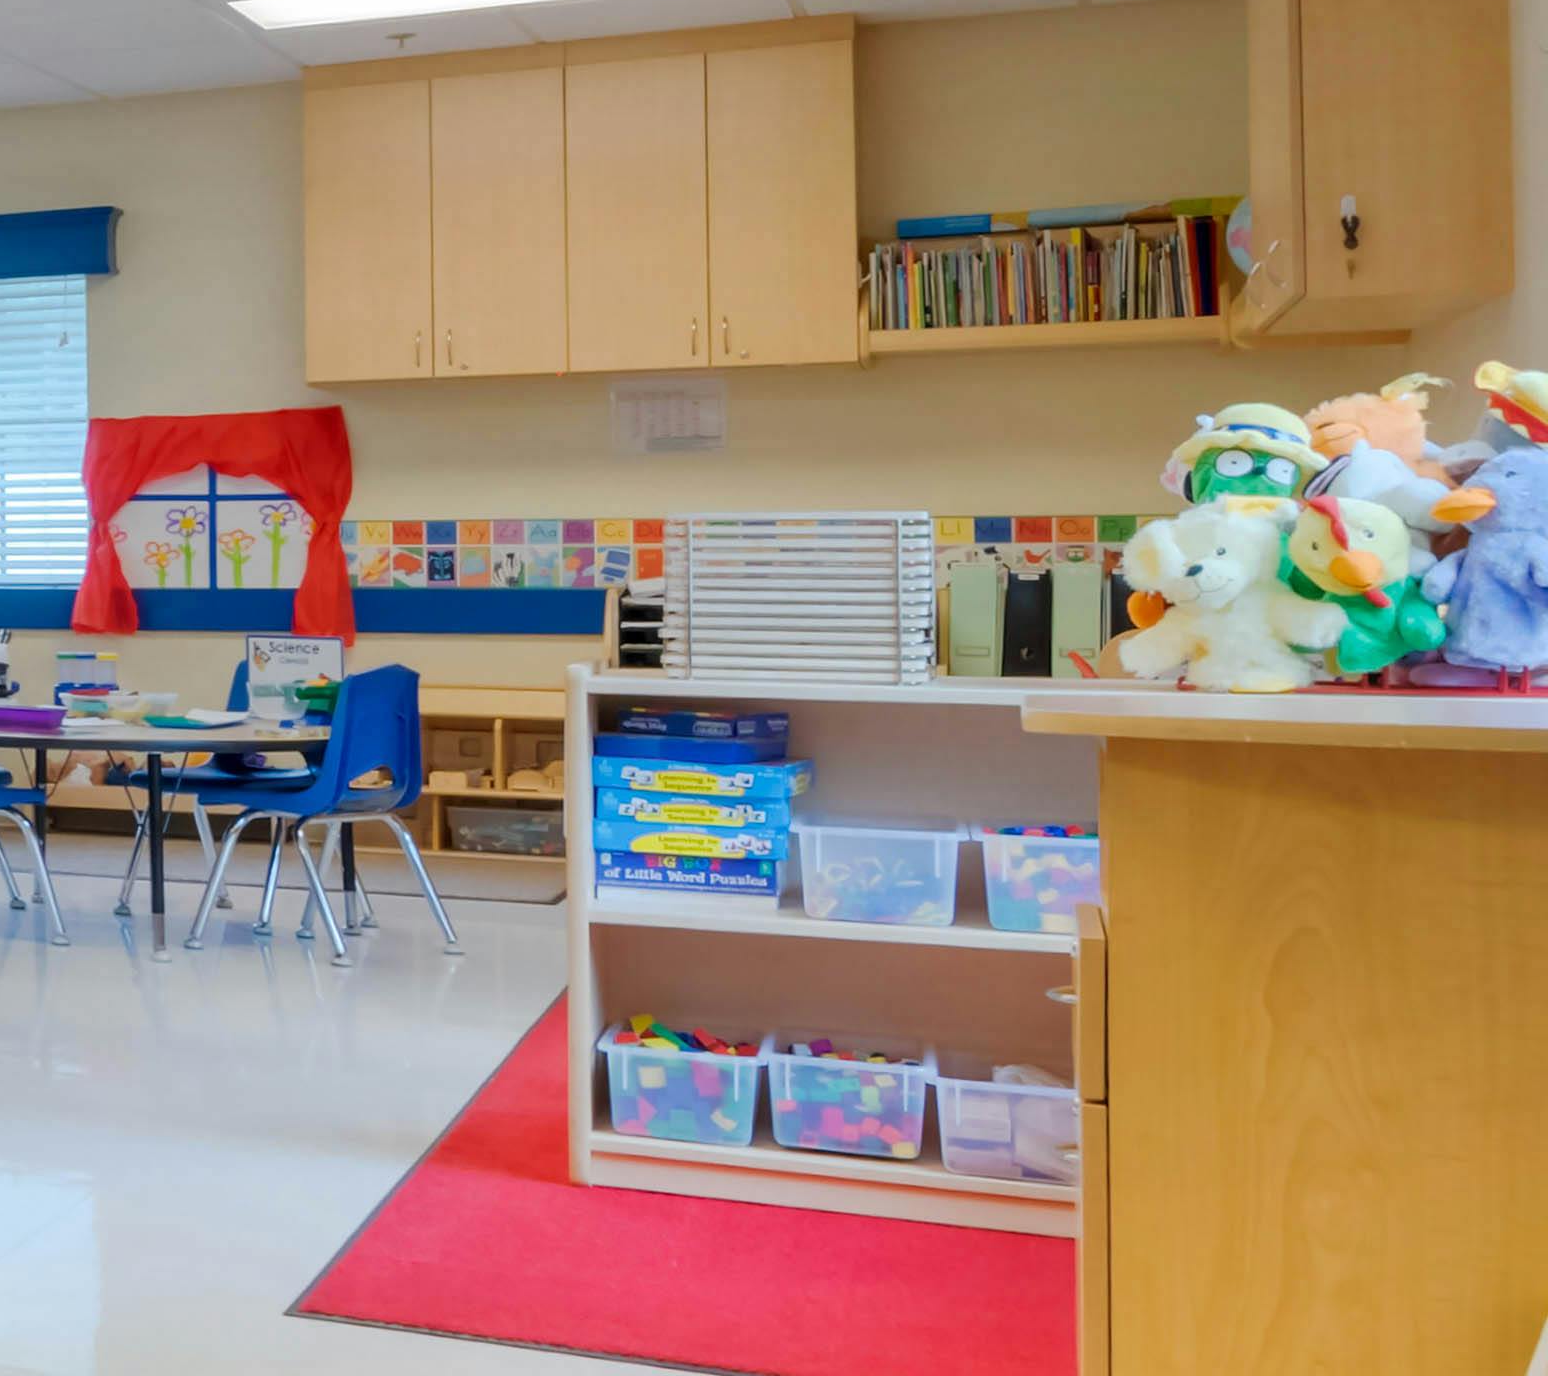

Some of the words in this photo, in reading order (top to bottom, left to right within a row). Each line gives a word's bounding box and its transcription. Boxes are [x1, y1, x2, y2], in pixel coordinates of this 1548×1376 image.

[465, 525, 486, 543] Yy
[530, 524, 556, 539] Aa
[601, 523, 626, 538] Cc
[940, 519, 961, 537] Ll
[1059, 519, 1091, 536] Oo
[1101, 519, 1131, 542] Pp
[268, 641, 320, 655] Science
[645, 854, 677, 869] BIG
[683, 857, 722, 872] BOX
[604, 868, 619, 879] of
[625, 867, 662, 881] Little
[667, 870, 706, 884] Word
